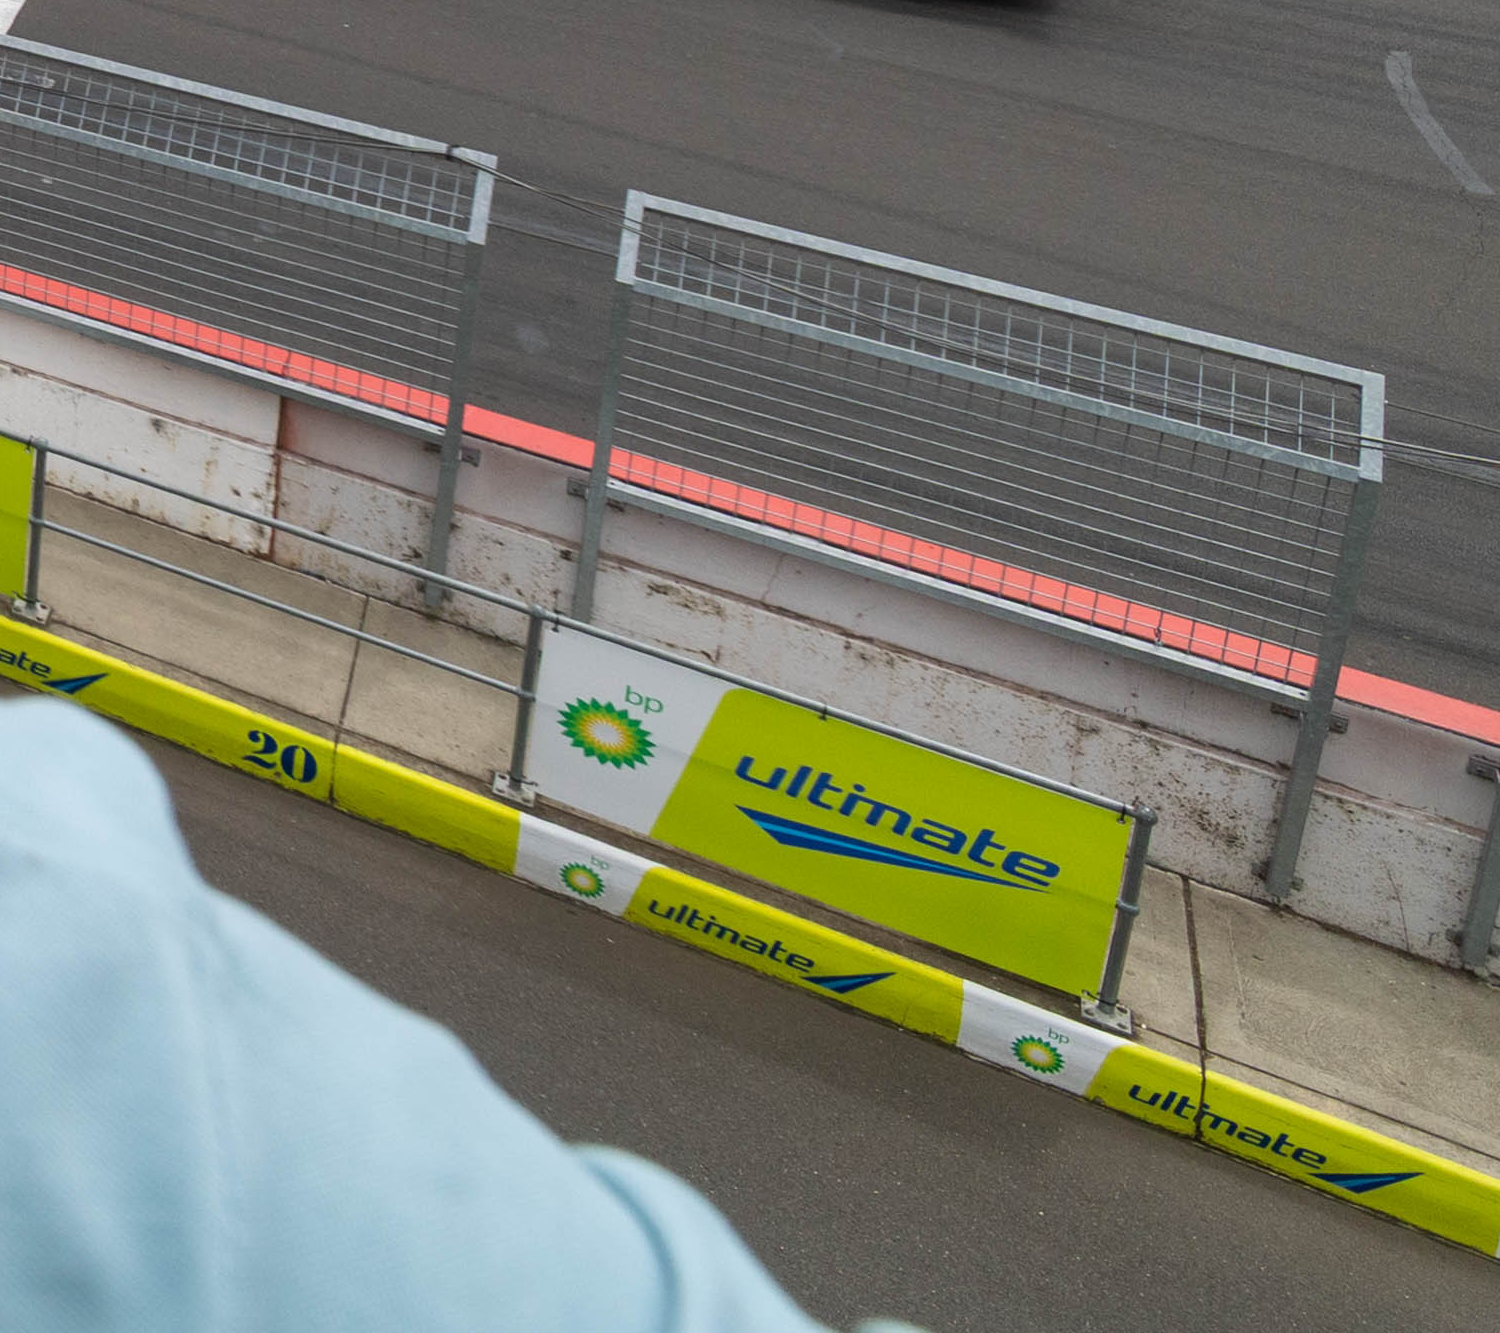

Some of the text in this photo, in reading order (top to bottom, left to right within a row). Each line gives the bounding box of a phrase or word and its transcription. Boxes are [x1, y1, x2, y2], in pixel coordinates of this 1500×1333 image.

[624, 683, 664, 718] bp
[241, 729, 319, 784] 20
[733, 751, 1062, 887] ultimate
[589, 854, 609, 872] bp
[649, 897, 816, 976] ultimate
[1047, 1027, 1071, 1046] bp
[1127, 1082, 1328, 1169] ultimate
